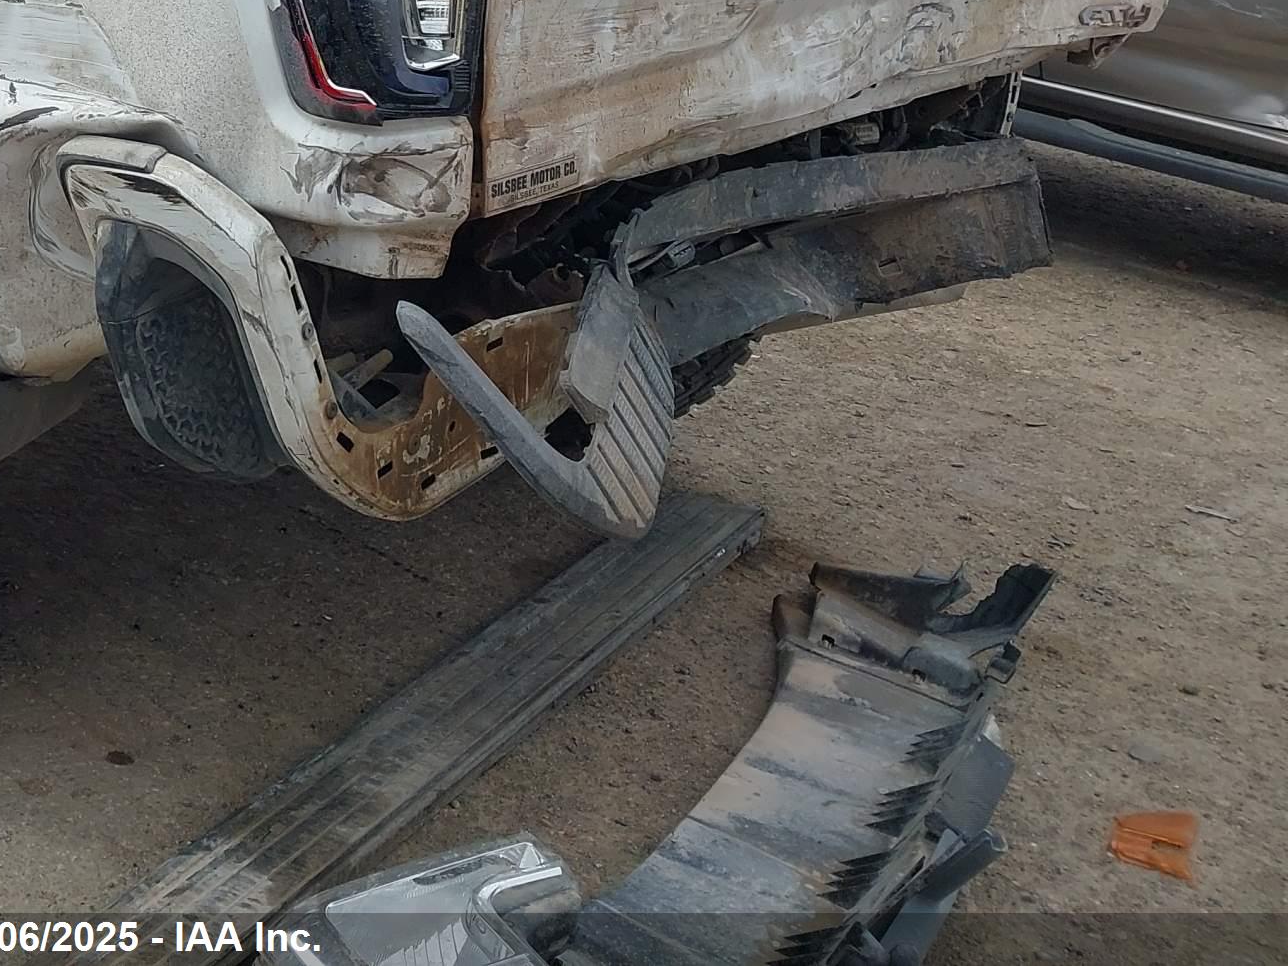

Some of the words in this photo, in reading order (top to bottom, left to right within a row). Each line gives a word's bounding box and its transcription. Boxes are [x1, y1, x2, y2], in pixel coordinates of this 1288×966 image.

[491, 174, 527, 198] SILSBEE
[530, 165, 561, 187] MOTOR
[564, 160, 578, 177] CO.
[540, 181, 559, 194] TEXAS
